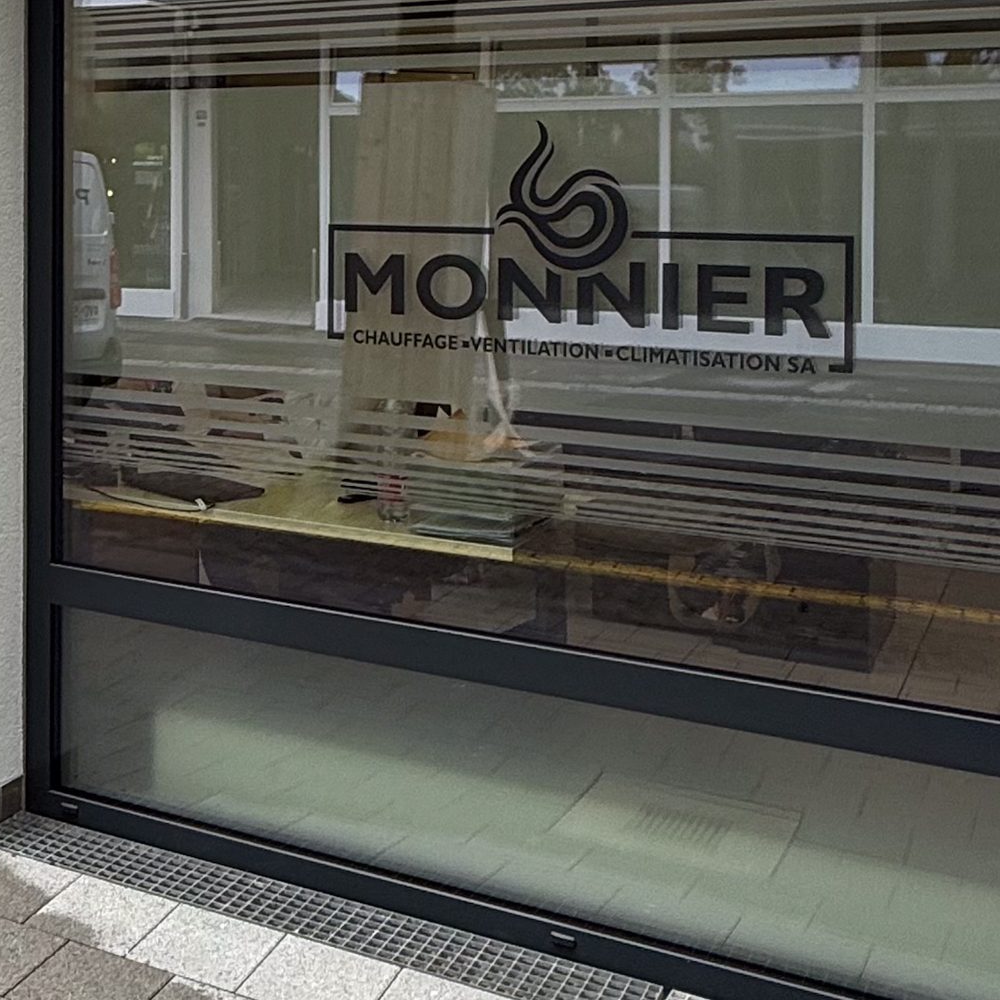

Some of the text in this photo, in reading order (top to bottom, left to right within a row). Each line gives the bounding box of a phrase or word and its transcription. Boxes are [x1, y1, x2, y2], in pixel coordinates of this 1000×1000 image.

[344, 252, 831, 339] MONNIER
[352, 328, 817, 375] CHAUFFAGE VENTILATION CLIMATISATION SA
